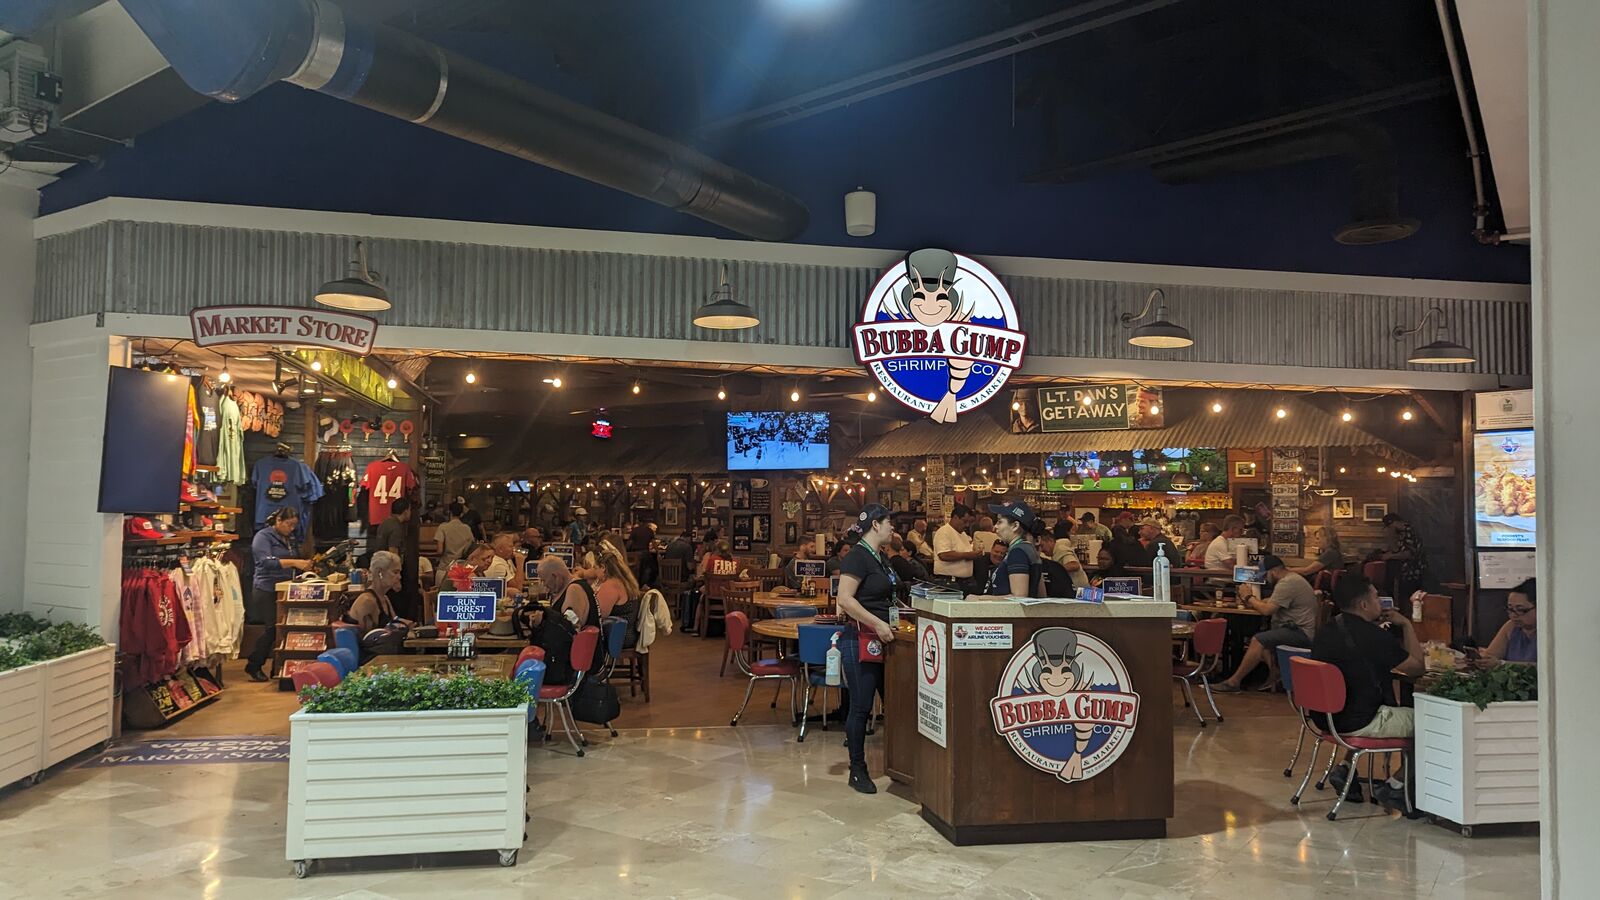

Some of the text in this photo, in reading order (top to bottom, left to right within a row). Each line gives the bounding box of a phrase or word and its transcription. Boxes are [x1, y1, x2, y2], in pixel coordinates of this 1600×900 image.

[197, 315, 369, 347] MARKET STORE
[860, 326, 1022, 362] BUBBA GUMP
[887, 360, 947, 372] SHRIMP
[873, 363, 934, 410] RESTAURANT
[971, 370, 1008, 405] MARKET
[1046, 391, 1070, 403] LT.
[373, 475, 402, 504] 44
[457, 598, 476, 606] RUN
[446, 605, 486, 613] FORREST
[456, 612, 475, 620] RUN
[999, 694, 1134, 728] BUBBA GUMP
[1022, 724, 1073, 738] SHRIMP
[151, 740, 290, 749] WELCOM
[169, 745, 210, 753] TO
[1010, 731, 1061, 770] RESTAURANT
[1094, 730, 1122, 762] MARKET
[100, 751, 290, 763] MARKET STOR
